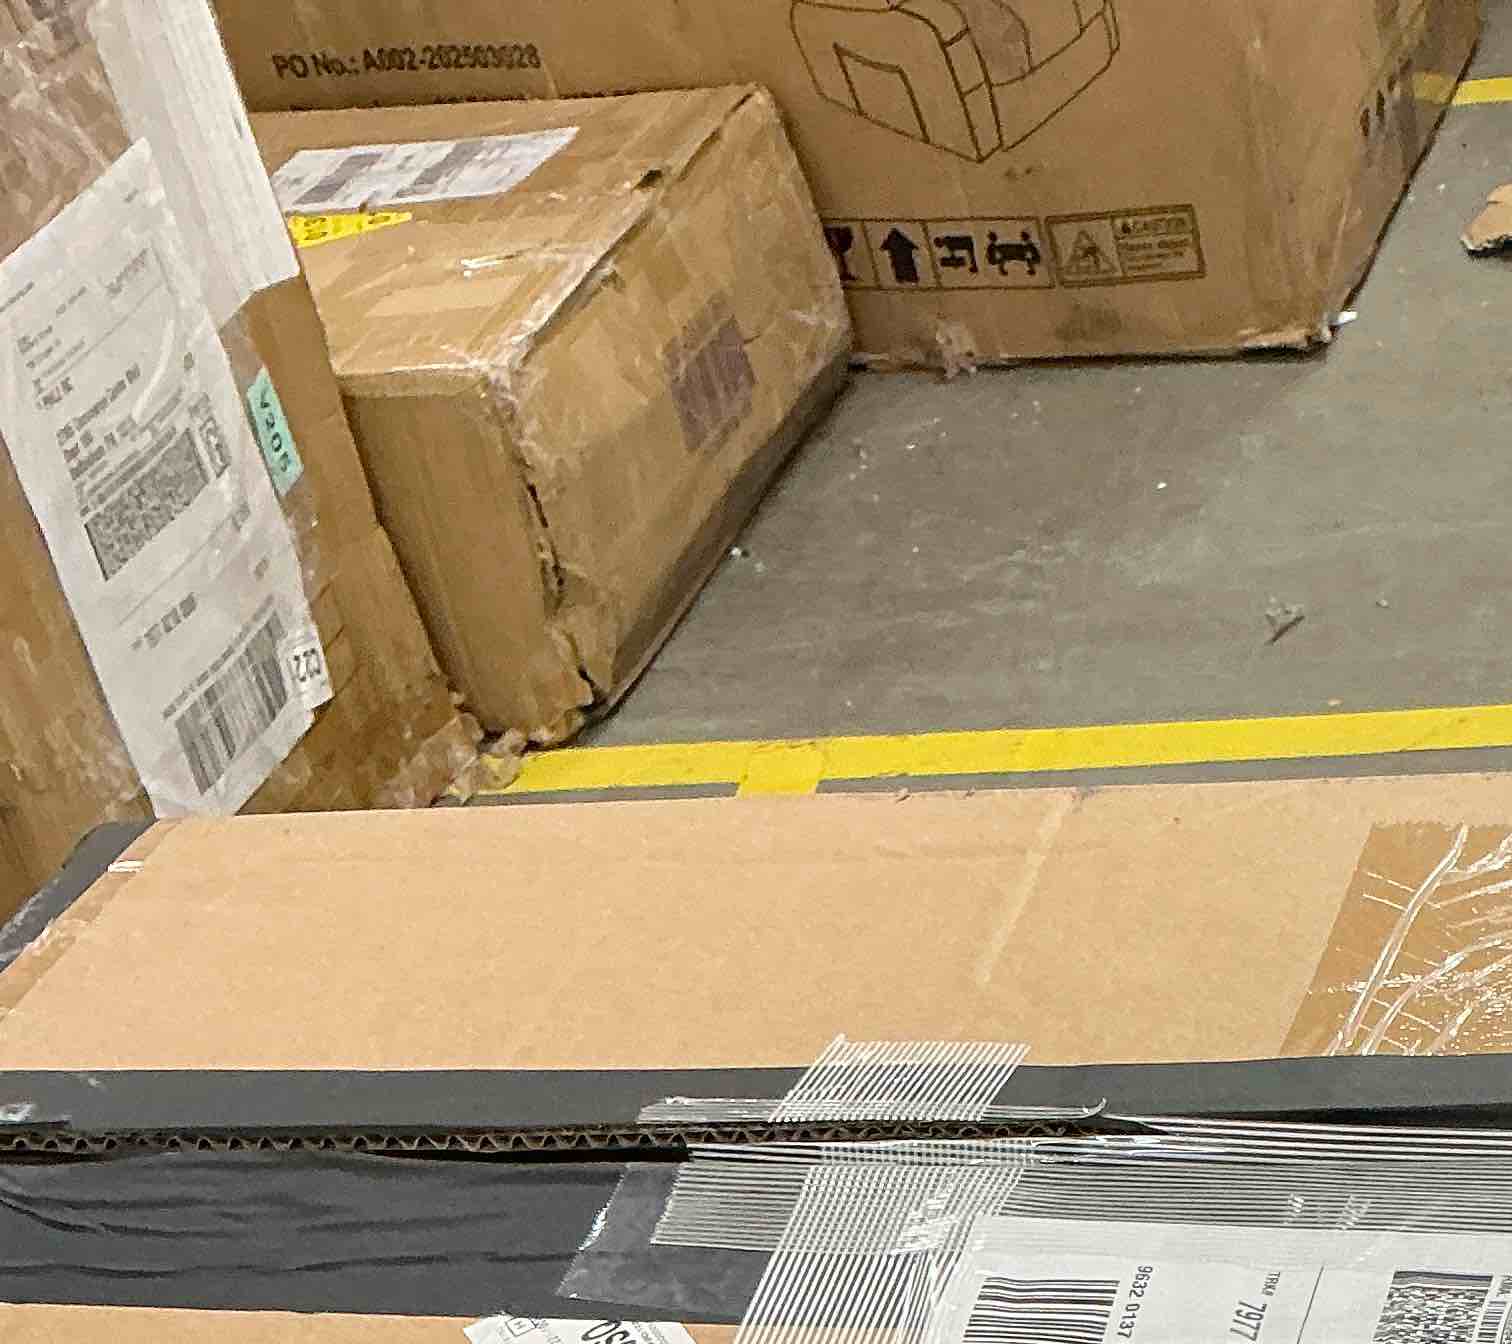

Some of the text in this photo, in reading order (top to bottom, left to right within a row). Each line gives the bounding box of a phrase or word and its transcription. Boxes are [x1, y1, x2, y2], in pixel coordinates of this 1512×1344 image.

[271, 54, 309, 80] PO
[1127, 1265, 1153, 1299] 9632
[1117, 1302, 1141, 1339] 0137
[1228, 1301, 1268, 1342] 7977
